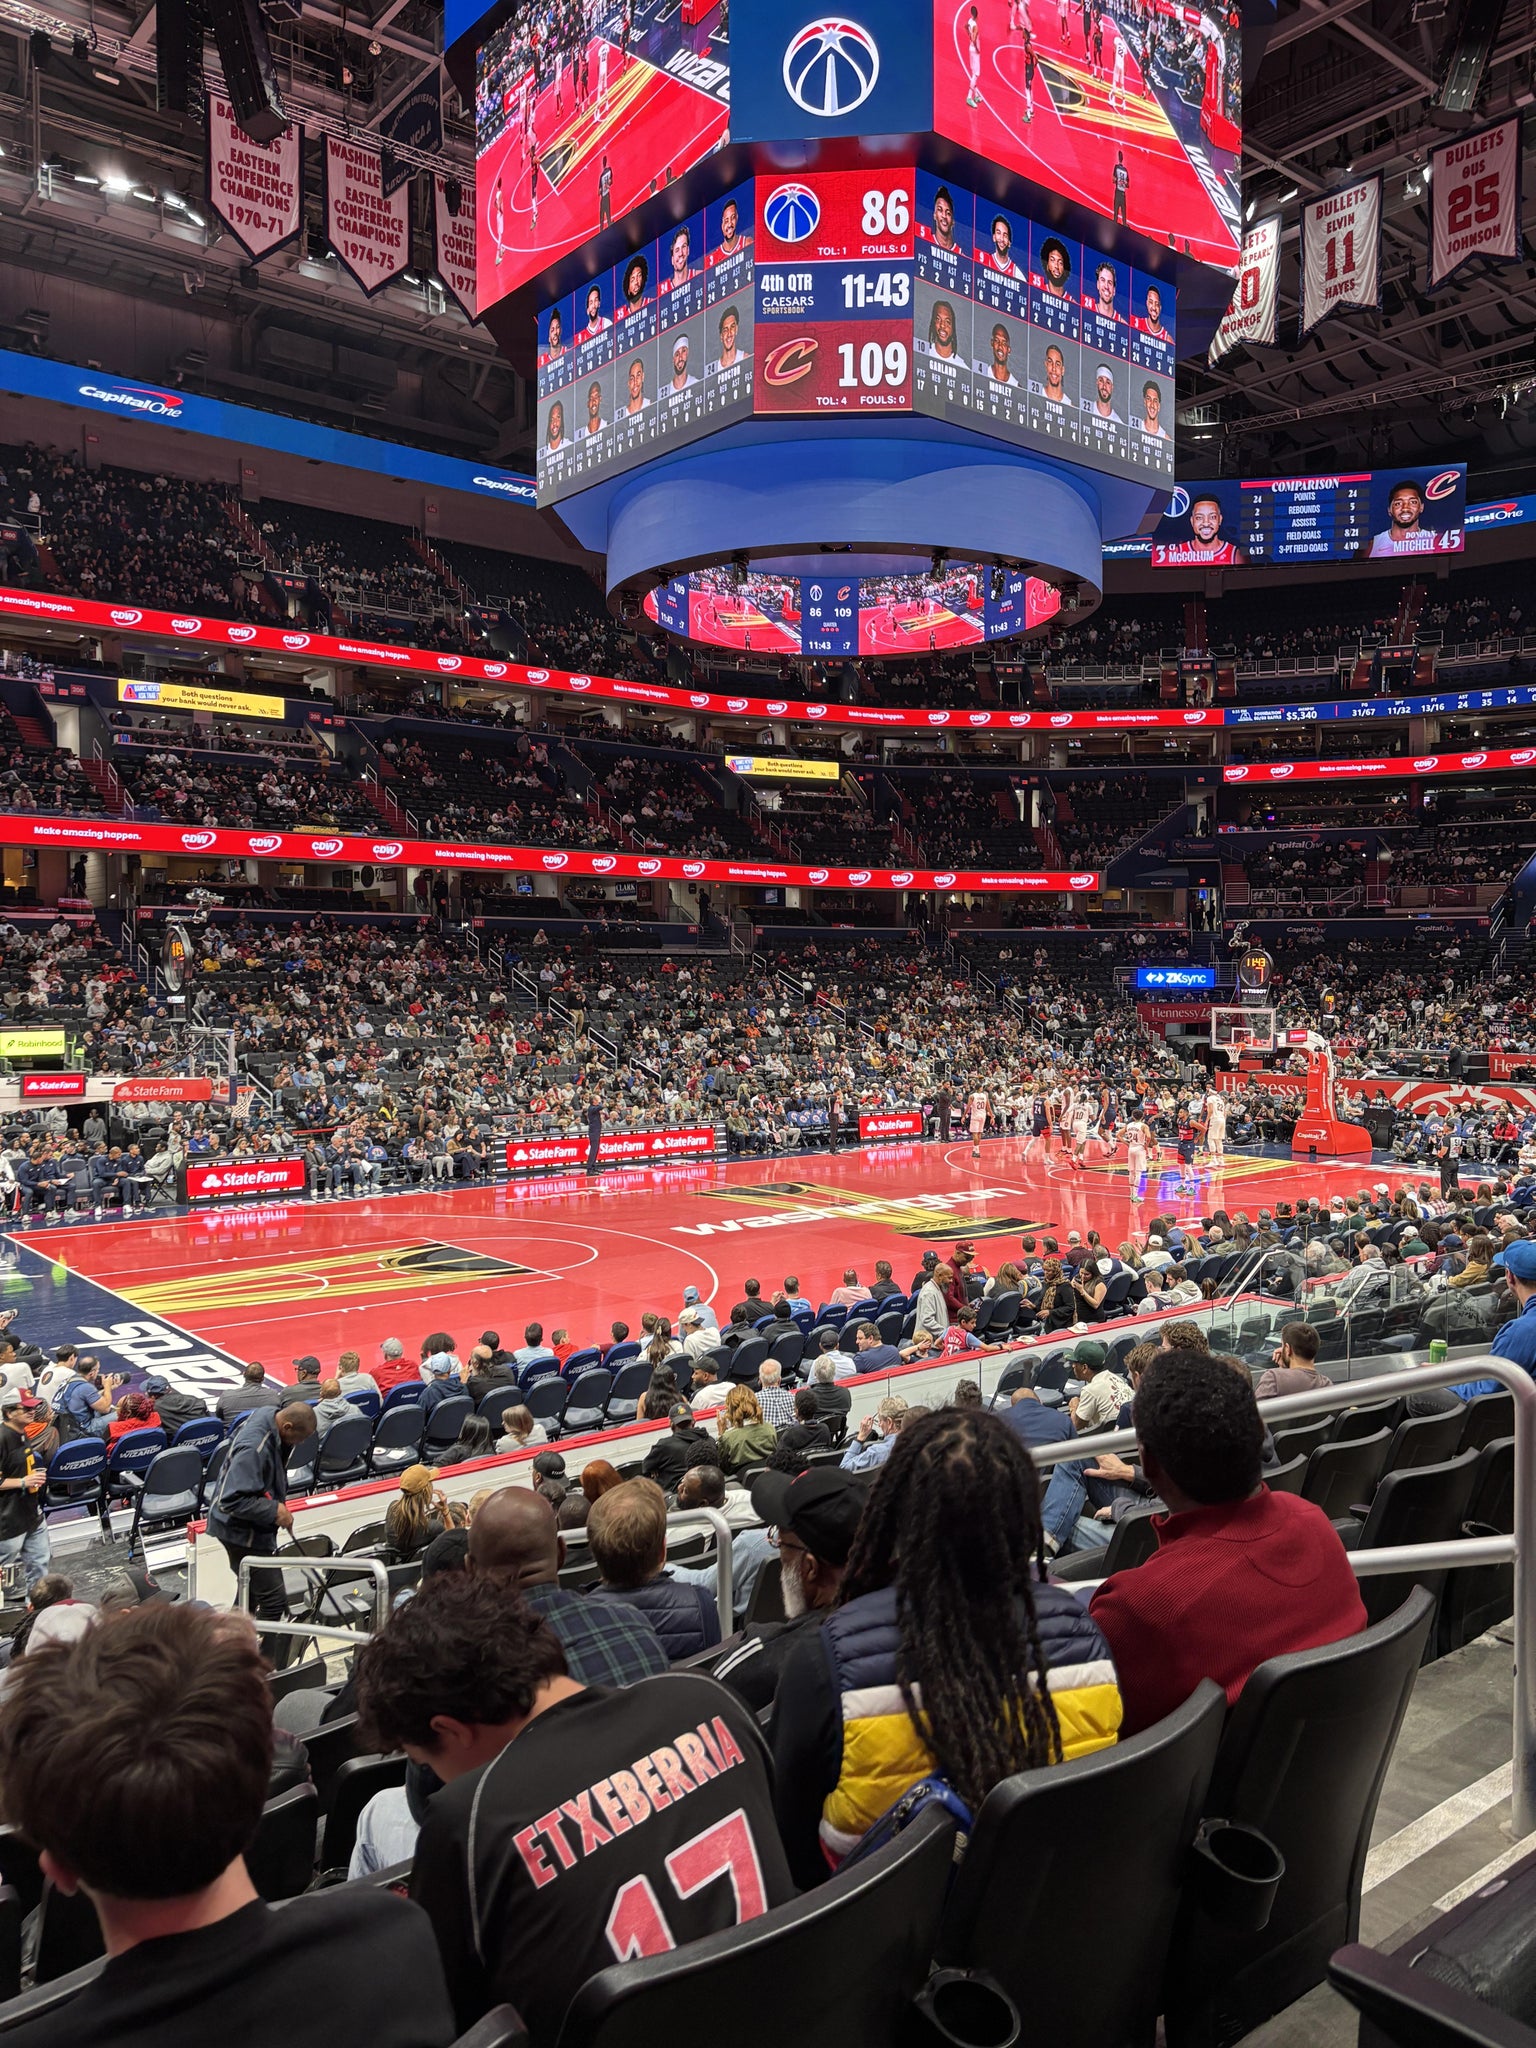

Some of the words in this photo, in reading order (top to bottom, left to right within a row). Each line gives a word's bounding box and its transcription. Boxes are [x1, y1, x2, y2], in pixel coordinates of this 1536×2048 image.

[1446, 129, 1504, 167] BULLETS
[231, 148, 280, 177] EASTERN
[1462, 160, 1485, 179] GUS
[218, 161, 293, 197] CONFERENCE
[220, 178, 290, 212] CHAMPIONS
[346, 187, 391, 214] EASTERN
[1316, 186, 1367, 221] BULLETS
[1448, 172, 1499, 234] 25
[334, 200, 403, 234] CONFERENCE
[862, 189, 910, 236] 86
[228, 204, 283, 236] 1970-71
[1326, 212, 1354, 234] ELVIN
[337, 217, 400, 248] CHAMPIONS
[920, 228, 925, 236] 5
[1447, 224, 1500, 255] JOHNSON
[344, 240, 394, 270] 1974-75
[818, 247, 840, 256] TOL:
[862, 245, 898, 254] FOULS:
[931, 246, 958, 265] WATKINS
[1325, 231, 1355, 281] 11
[979, 251, 984, 262] 9
[917, 253, 927, 264] PTS
[948, 266, 956, 276] AST
[761, 274, 782, 292] 4th
[788, 274, 812, 290] QTR
[1032, 276, 1042, 287] 35
[661, 284, 668, 294] 24
[842, 273, 910, 308] 11:43
[1325, 278, 1355, 299] HAYES
[762, 296, 814, 307] CAESARS
[1084, 298, 1092, 309] 24
[1096, 316, 1116, 331] KISPERT
[1222, 312, 1261, 334] MONROE
[917, 342, 926, 352] 10
[838, 341, 908, 388] 109
[929, 360, 956, 378] GARLAND
[978, 365, 983, 373] 4
[707, 366, 715, 375] 24
[917, 380, 925, 391] 17
[990, 382, 1012, 397] MOBLEY
[1032, 384, 1040, 394] 20
[661, 387, 668, 397] 22
[816, 396, 839, 405] TOL:
[841, 397, 847, 405] 4
[860, 396, 896, 405] FOULS:
[1083, 401, 1091, 411] 22
[1132, 418, 1139, 427] 24
[1272, 478, 1339, 492] COMPARISON
[1294, 492, 1315, 501] POINTS
[1348, 490, 1357, 498] 24
[1289, 506, 1320, 514] REBOUNDS
[1292, 519, 1316, 527] ASSISTS
[1287, 532, 1301, 540] FIELD
[1302, 531, 1321, 539] GOALS
[1344, 529, 1359, 537] 8/21
[1406, 530, 1437, 540] DONOVAN
[1394, 539, 1435, 553] MITCHELL
[1438, 529, 1460, 548] 45
[1279, 546, 1292, 554] 3-PT
[1293, 544, 1307, 553] FIELD
[1308, 543, 1328, 552] GOALS
[1344, 542, 1359, 550] 4/10
[1156, 545, 1166, 563] 3
[1169, 551, 1214, 562] McCOLLUM
[1010, 582, 1022, 594] 109
[4, 596, 40, 608] amazing
[42, 602, 75, 612] happen.
[111, 610, 135, 620] CDW
[810, 608, 821, 617] 86
[834, 608, 852, 617] 109
[171, 619, 194, 629] CDW
[990, 622, 1007, 634] 11:43
[228, 628, 249, 637] CDW
[283, 636, 303, 644] CDW
[339, 644, 356, 652] Make
[358, 648, 384, 658] amazing
[386, 651, 410, 660] happen.
[179, 697, 196, 705] bank
[182, 690, 198, 698] Both
[200, 694, 232, 702] questions
[1352, 708, 1375, 716] 31/67
[1388, 706, 1411, 715] 11/32
[1421, 704, 1444, 712] 13/16
[1458, 701, 1468, 709] 24
[1507, 696, 1517, 704] 14
[1286, 711, 1317, 720] $5,340
[1462, 756, 1480, 765] CDW
[1510, 753, 1530, 761] CDW
[1414, 760, 1432, 768] CDW
[1226, 768, 1243, 777] CDW
[1270, 766, 1288, 775] CDW
[34, 826, 60, 835] Make
[62, 829, 102, 840] amazing
[104, 831, 142, 841] happen.
[182, 834, 208, 844] CDW
[249, 838, 274, 847] CDW
[312, 842, 336, 850] CDW
[373, 845, 396, 854] CDW
[436, 850, 454, 858] Make
[456, 852, 485, 861] amazing
[486, 853, 513, 862] happen.
[543, 856, 562, 864] CDW
[592, 858, 611, 867] CDW
[638, 861, 656, 870] CDW
[683, 864, 700, 872] CDW
[616, 883, 636, 891] CLARK
[1166, 972, 1206, 986] ZKsync
[1152, 1008, 1199, 1018] Hennessy
[1489, 1026, 1510, 1034] NOISE
[18, 1040, 62, 1048] Robinhood
[976, 1101, 985, 1110] 20
[670, 1185, 1026, 1235] washington
[120, 1446, 162, 1458] WIZARDS
[60, 1456, 104, 1471] WIZARDS
[512, 1716, 745, 1888] ETXEBERRIA
[606, 1808, 767, 1963] 17
